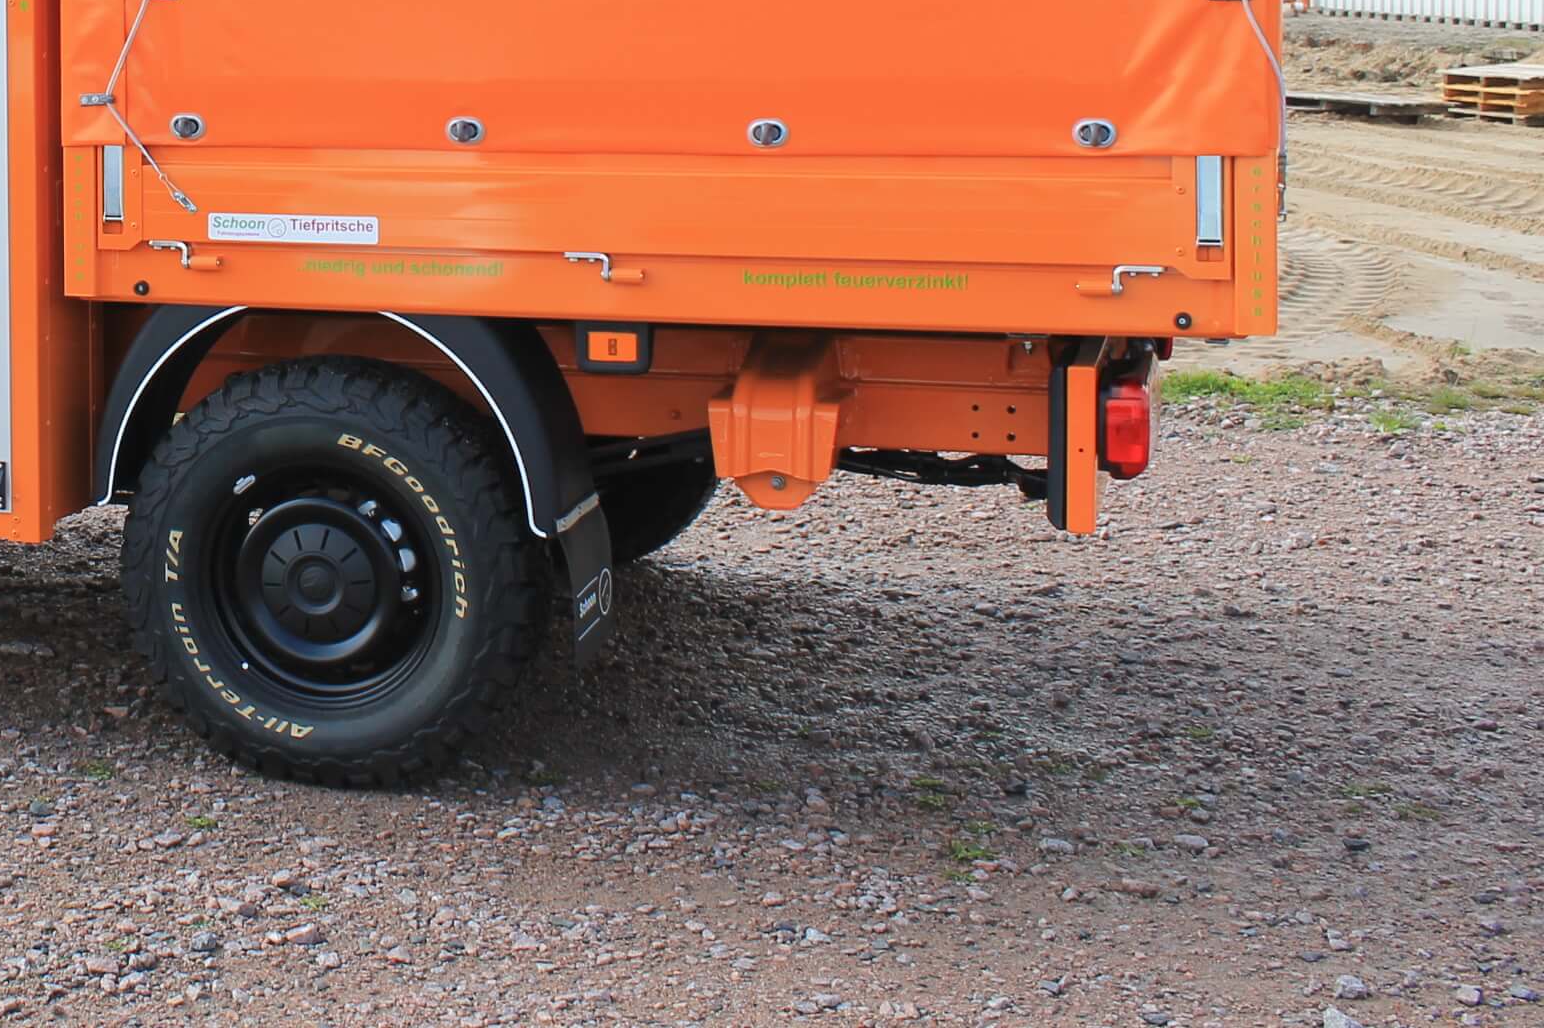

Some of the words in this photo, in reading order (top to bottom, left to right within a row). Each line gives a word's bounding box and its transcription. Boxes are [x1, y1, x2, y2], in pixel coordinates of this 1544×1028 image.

[213, 216, 265, 229] Schoon
[290, 218, 373, 234] Tiefpritsche
[373, 258, 405, 276] und
[743, 270, 827, 288] komplett
[832, 270, 970, 291] feuerverzinkt!
[336, 433, 469, 619] BFGoodrich
[164, 529, 185, 583] T/A
[171, 602, 315, 740] All-Terrain
